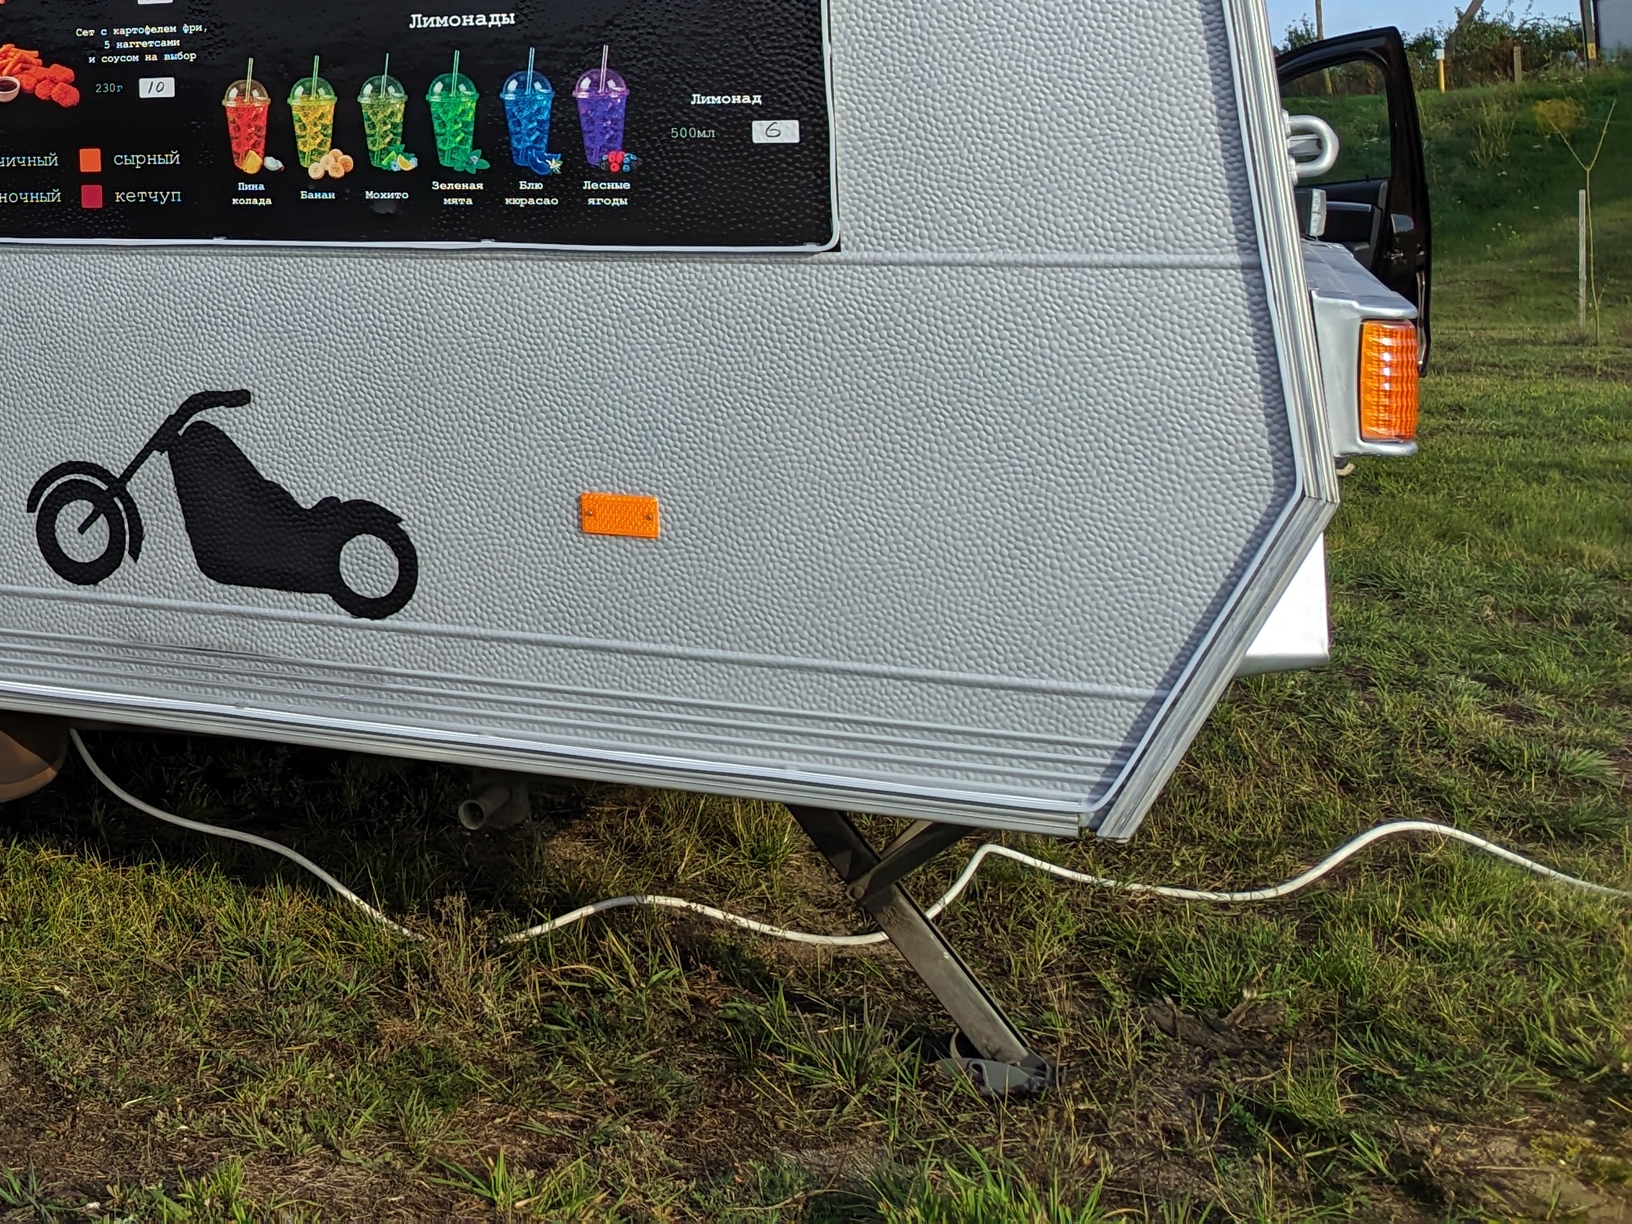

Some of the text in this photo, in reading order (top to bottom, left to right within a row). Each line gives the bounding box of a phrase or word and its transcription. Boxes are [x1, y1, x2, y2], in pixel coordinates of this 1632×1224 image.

[409, 12, 516, 29] Лимонады
[75, 23, 207, 37] Сет с картофелем фри,
[104, 39, 180, 49] 5 наггетсами
[88, 56, 96, 64] и
[101, 55, 140, 64] соусом
[163, 51, 197, 62] выбор
[95, 82, 123, 93] 230г
[148, 80, 165, 95] 10
[690, 93, 762, 105] Лимонад
[671, 126, 716, 139] 500мл
[765, 121, 782, 138] 6
[113, 150, 181, 169] сырный
[238, 182, 266, 191] Пина
[431, 181, 484, 190] Зеленая
[519, 180, 544, 190] Блю
[582, 180, 631, 190] Лесные
[115, 191, 182, 205] кетчуп
[300, 190, 336, 200] Банан
[365, 190, 409, 199] Мохито
[232, 198, 273, 206] колада
[504, 197, 559, 208] кюрасао
[587, 198, 628, 207] ягоды
